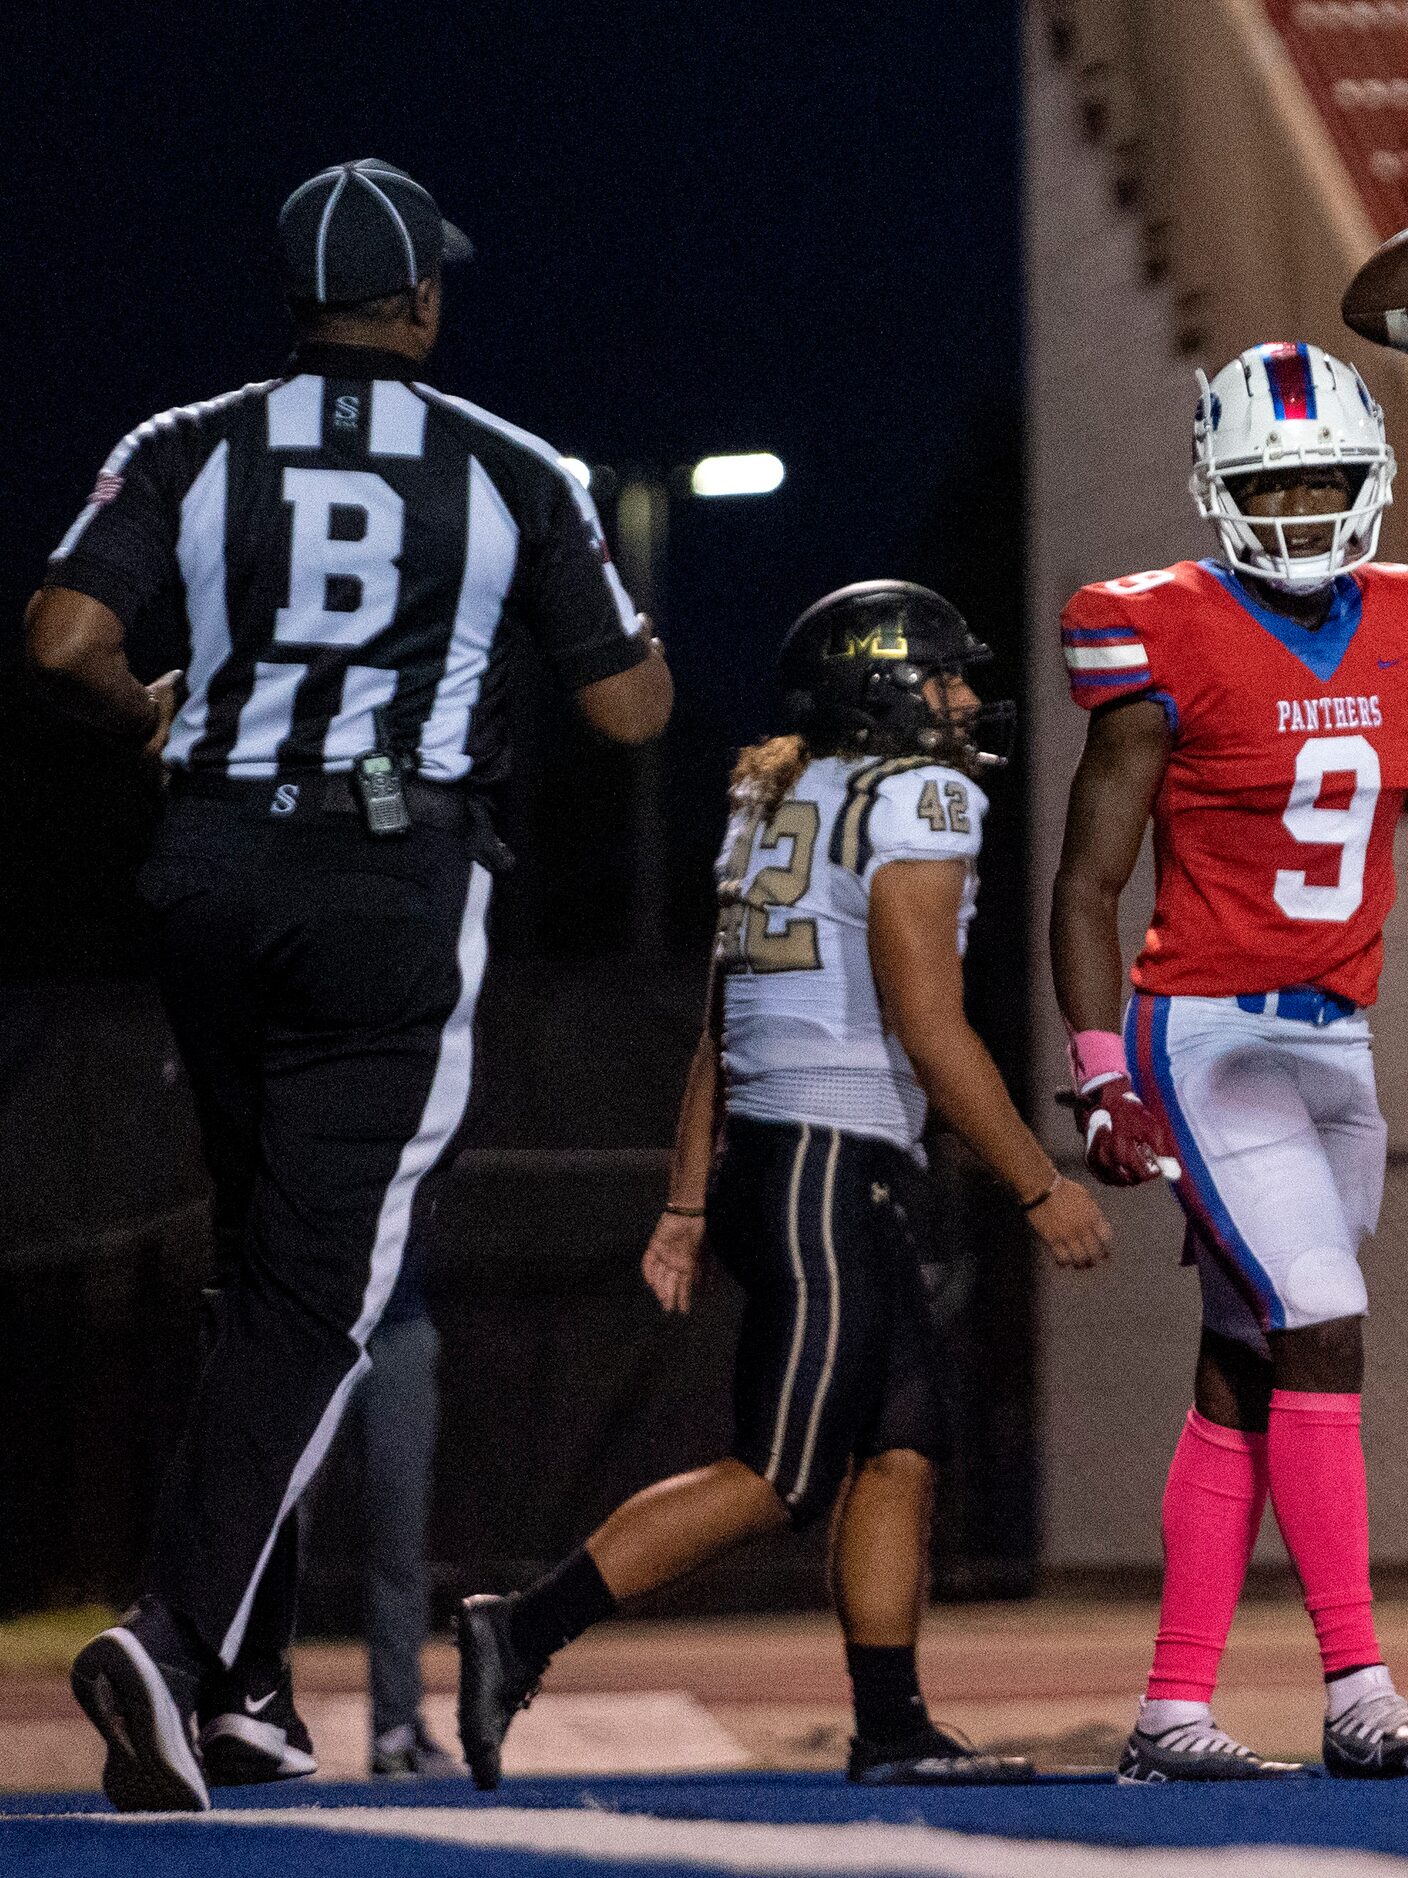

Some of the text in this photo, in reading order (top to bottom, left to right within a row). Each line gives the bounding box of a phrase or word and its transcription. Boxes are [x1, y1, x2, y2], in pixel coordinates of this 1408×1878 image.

[273, 466, 405, 648] B
[1277, 695, 1383, 732] PANTHERS
[270, 784, 300, 814] S
[917, 779, 970, 834] 42
[1273, 734, 1382, 922] 9
